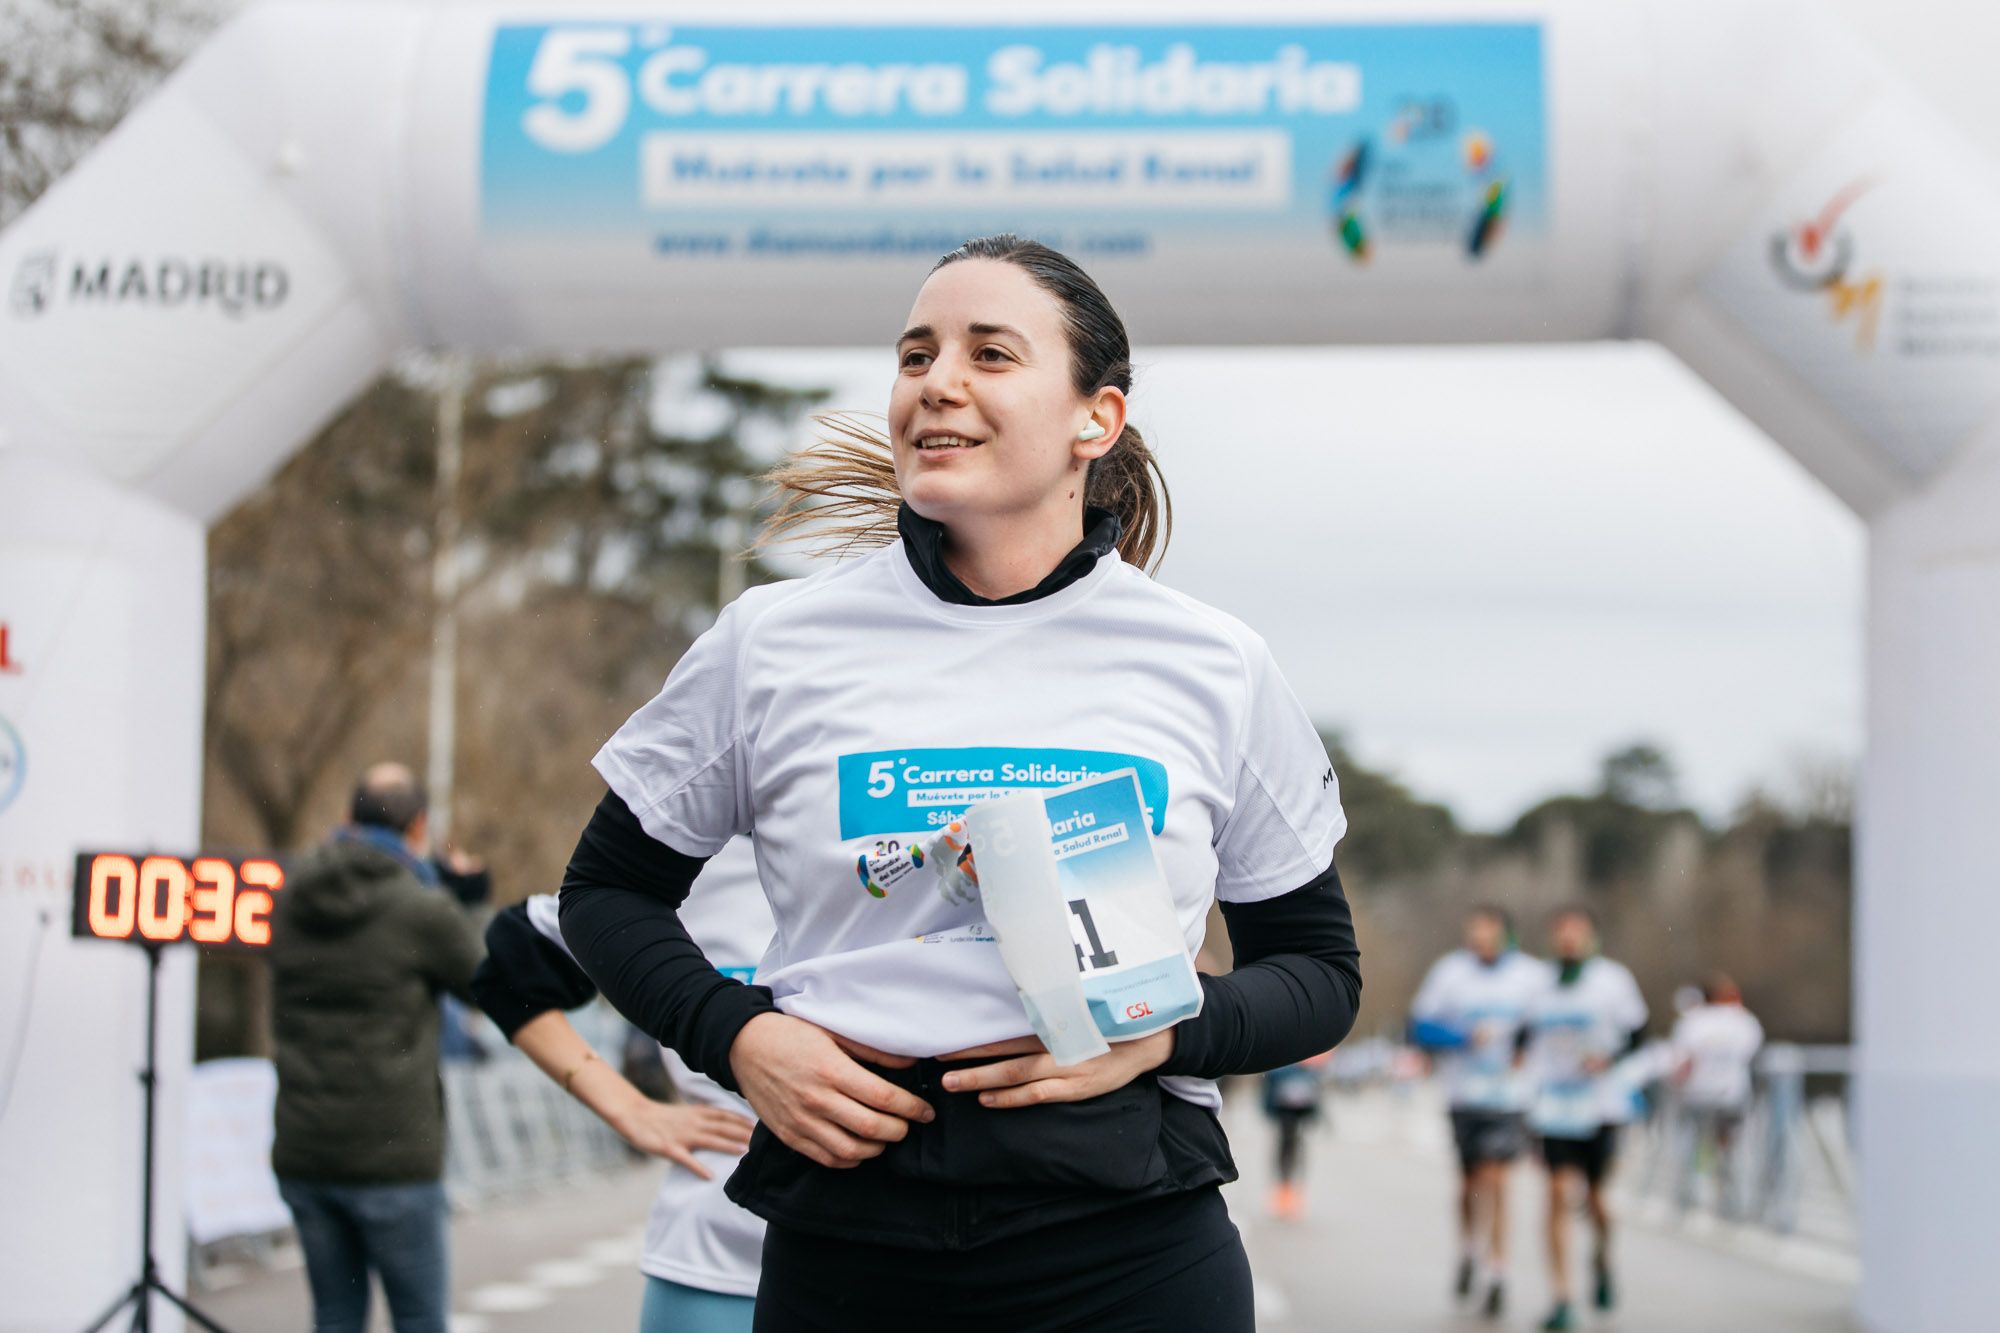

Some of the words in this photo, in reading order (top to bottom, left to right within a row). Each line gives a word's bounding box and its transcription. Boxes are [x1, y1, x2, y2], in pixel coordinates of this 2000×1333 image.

[637, 45, 967, 117] Carrera
[987, 43, 1363, 116] Solidaria
[69, 258, 290, 319] MADRID
[903, 765, 994, 784] Carrera
[916, 791, 965, 801] Muévete
[968, 791, 986, 802] por
[990, 791, 1000, 800] la
[1052, 810, 1096, 837] aria
[1063, 838, 1092, 853] Salud
[1094, 828, 1122, 843] Renal
[1126, 1002, 1153, 1020] CSL
